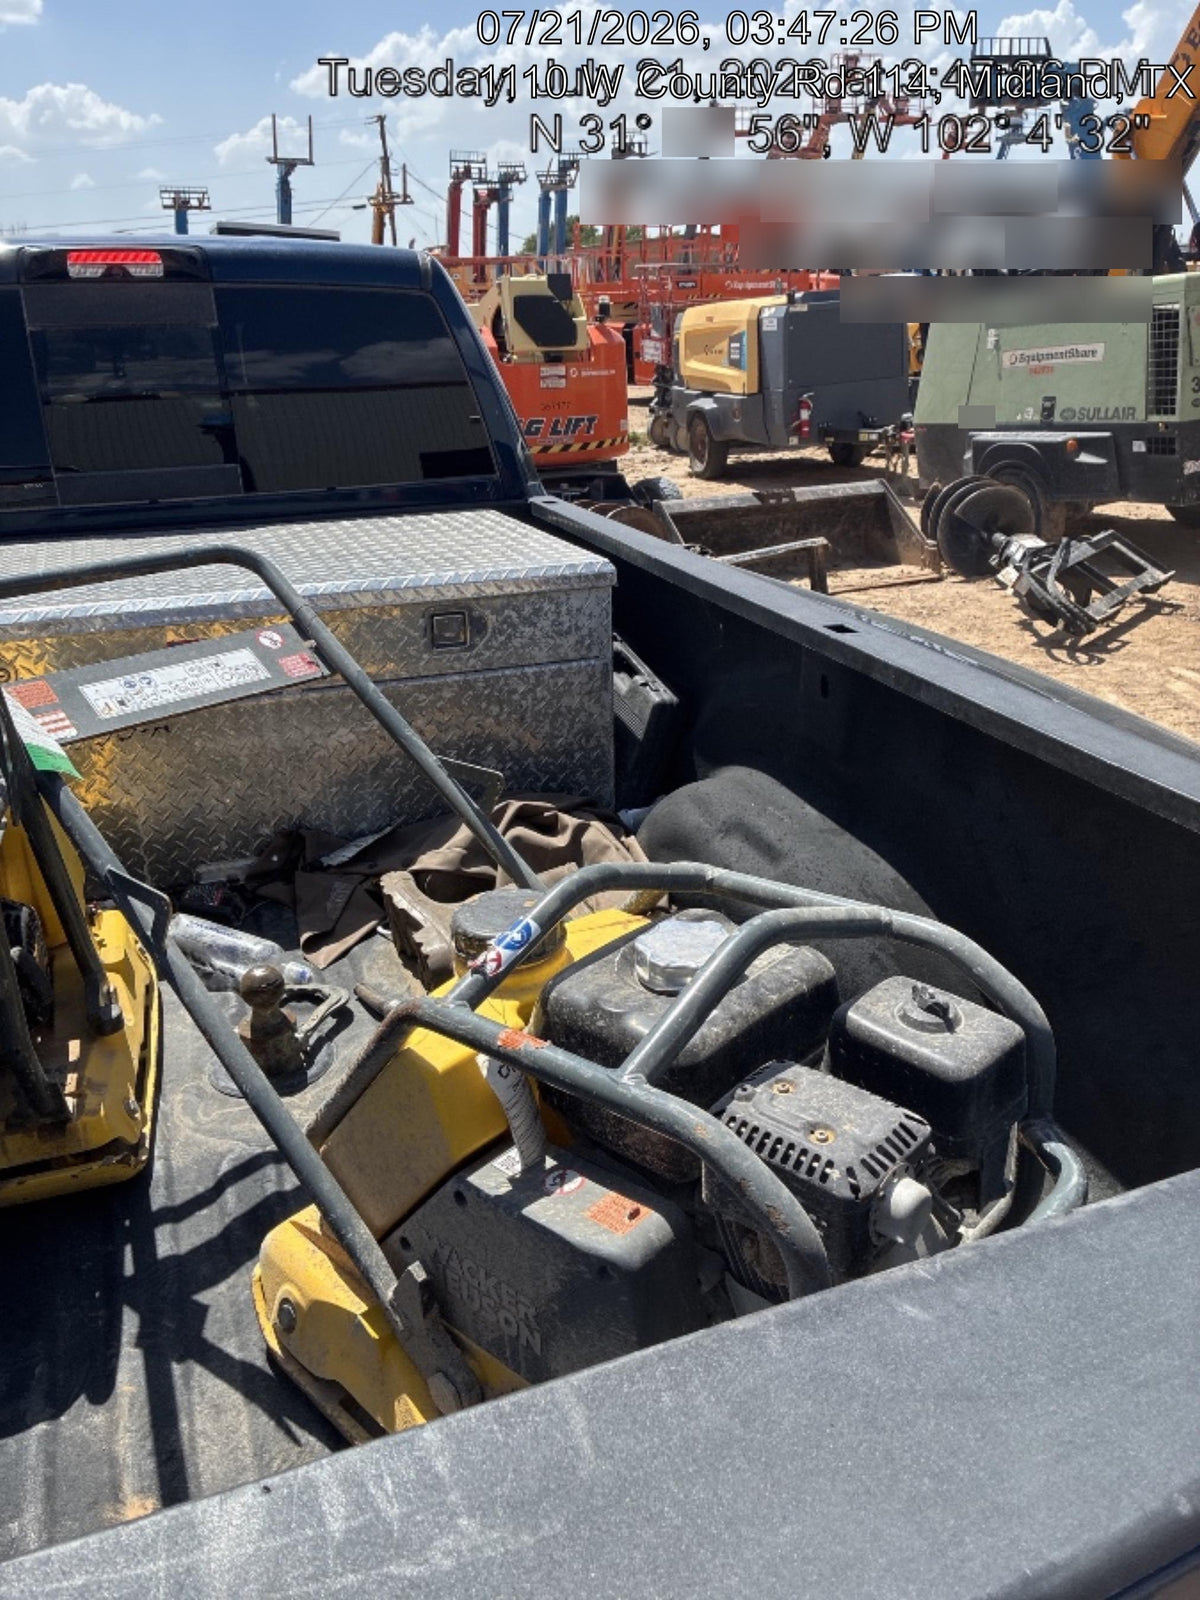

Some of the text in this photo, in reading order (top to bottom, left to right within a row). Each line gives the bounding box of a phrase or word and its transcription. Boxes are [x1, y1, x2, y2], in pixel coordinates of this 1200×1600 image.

[1019, 348, 1098, 364] EquipmentShare
[1077, 406, 1137, 421] SULLAIR
[548, 414, 599, 437] LIFT
